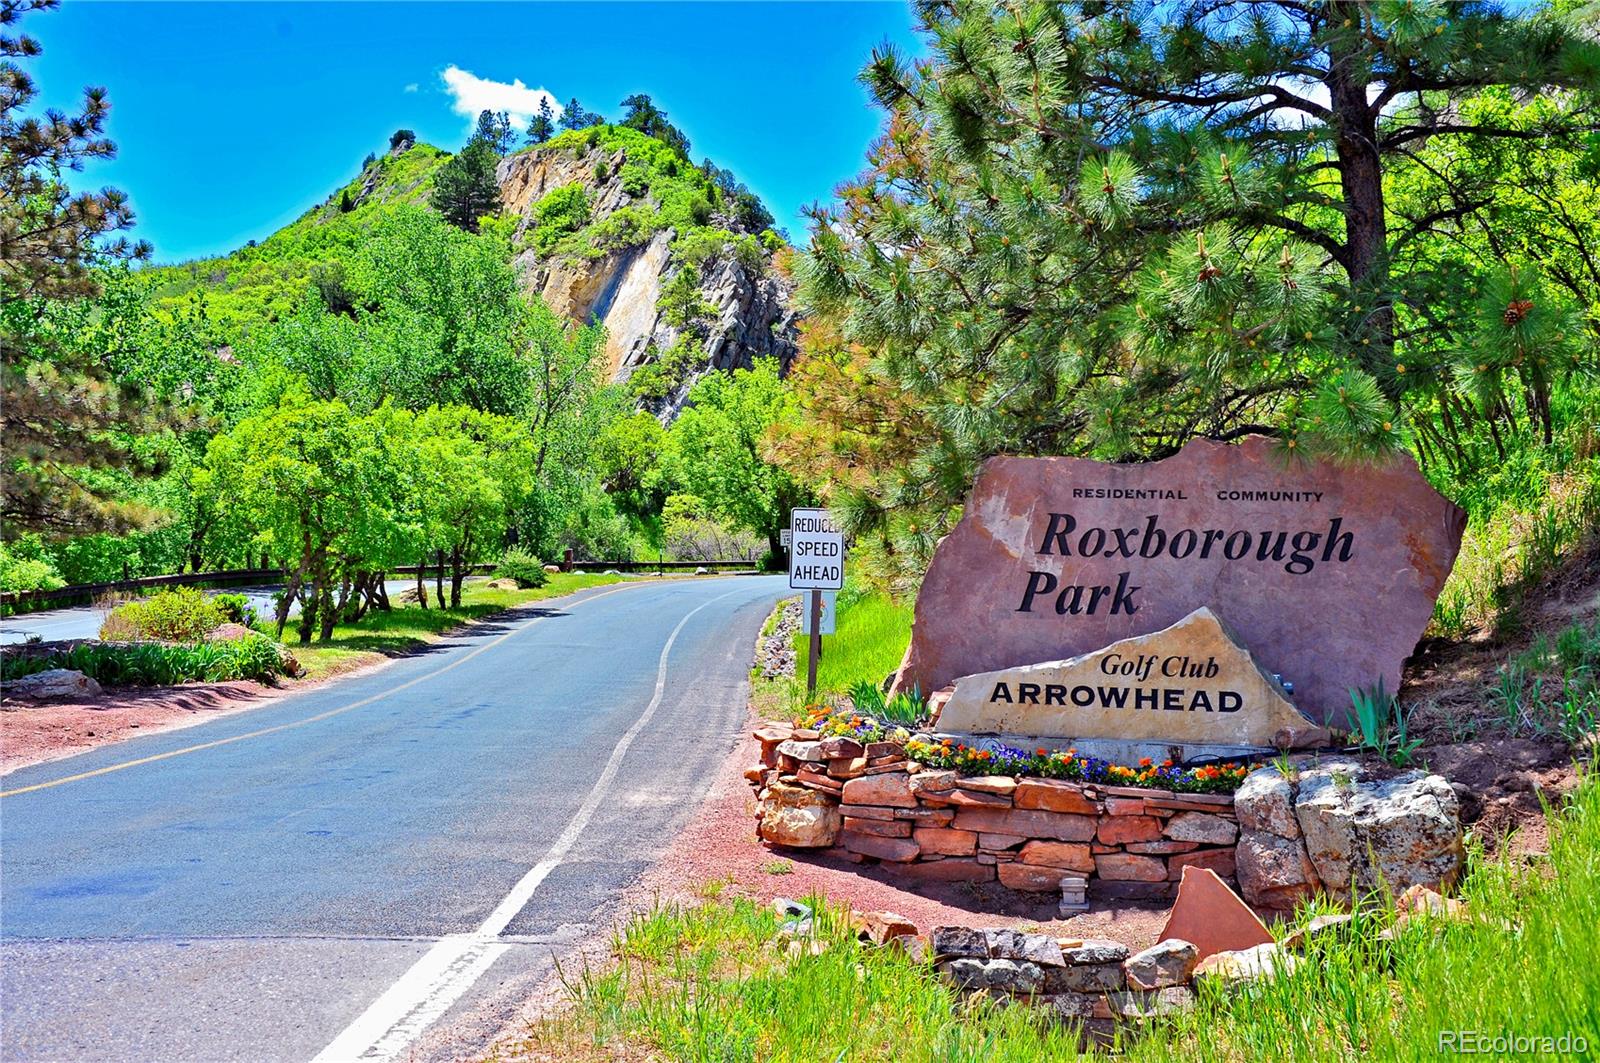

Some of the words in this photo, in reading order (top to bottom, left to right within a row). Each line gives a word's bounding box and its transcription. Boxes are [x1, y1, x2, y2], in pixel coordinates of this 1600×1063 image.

[1072, 487, 1188, 501] RESIDENTIAL
[1217, 489, 1324, 503] COMMUNITY
[796, 541, 838, 557] SPEED
[1034, 512, 1355, 575] Roxborough
[794, 565, 840, 581] AHEAD
[1015, 570, 1142, 616] Park
[1100, 653, 1158, 681] Golf
[1161, 655, 1220, 679] Club
[989, 682, 1243, 713] ARROWHEAD
